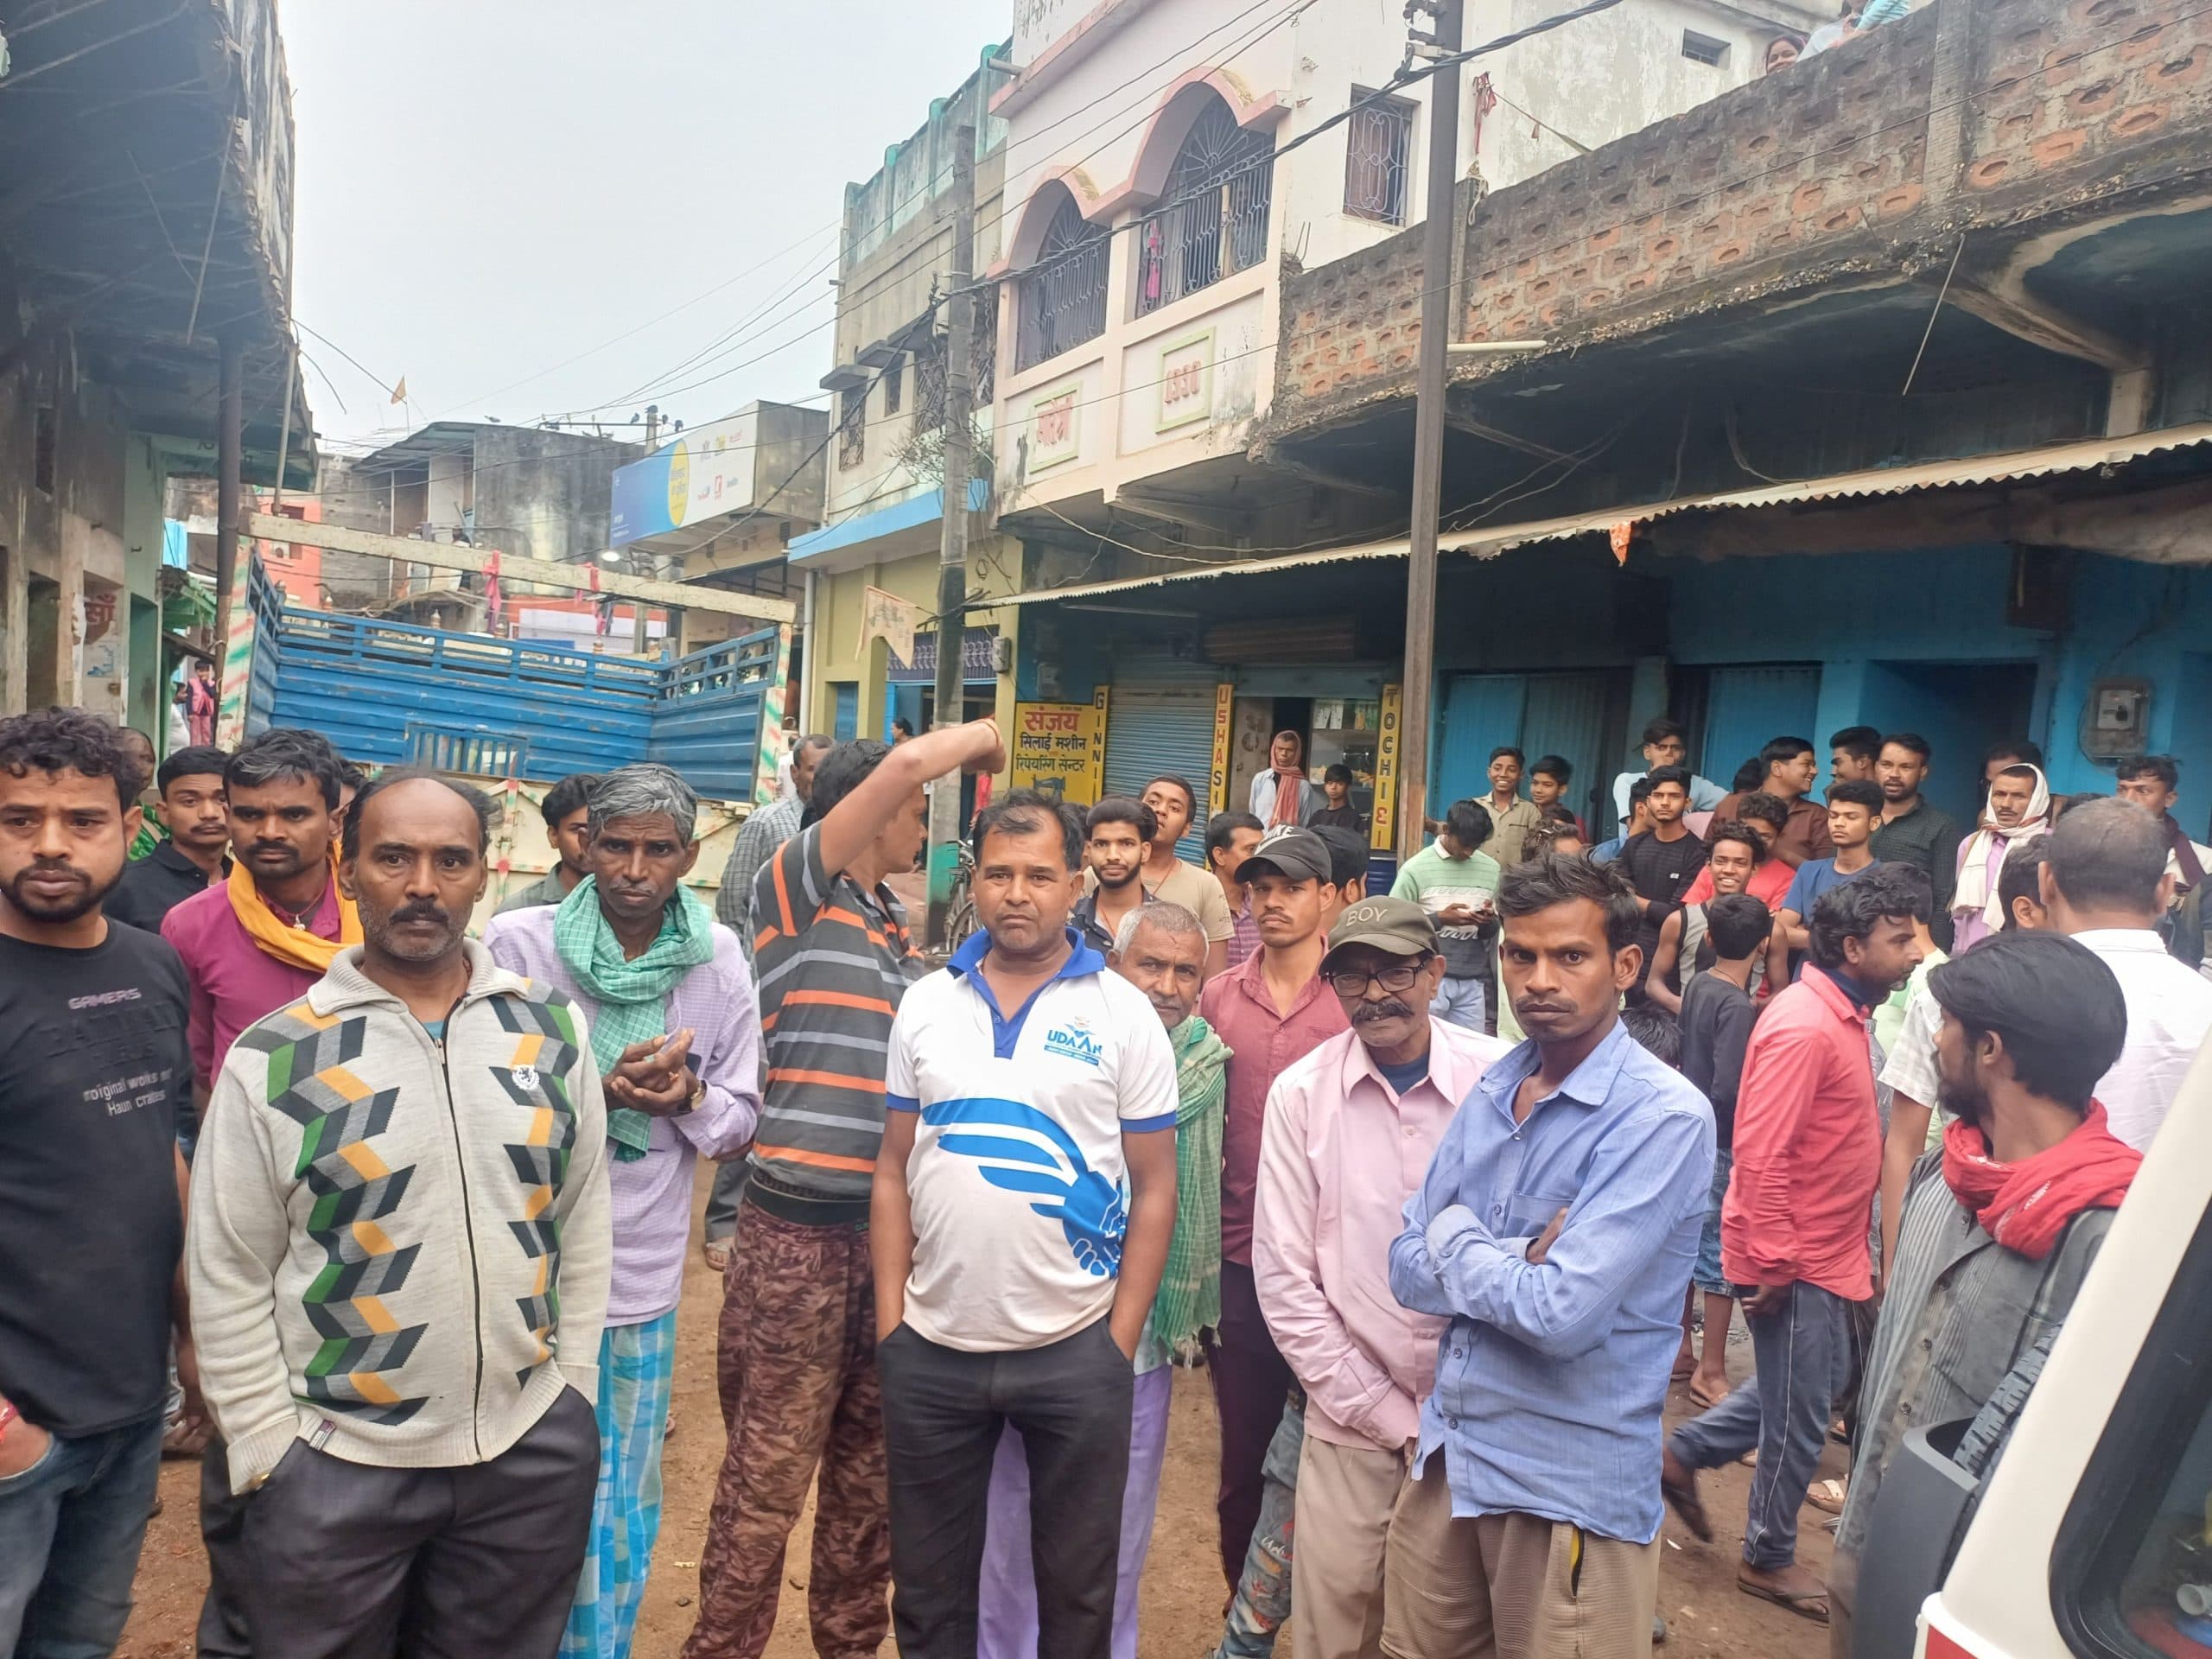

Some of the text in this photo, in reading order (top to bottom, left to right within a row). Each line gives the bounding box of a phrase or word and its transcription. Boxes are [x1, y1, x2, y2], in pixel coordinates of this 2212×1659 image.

[1025, 706, 1081, 732] संजय
[1020, 732, 1087, 752] सिलाई मशीन
[1346, 906, 1389, 927] BOY
